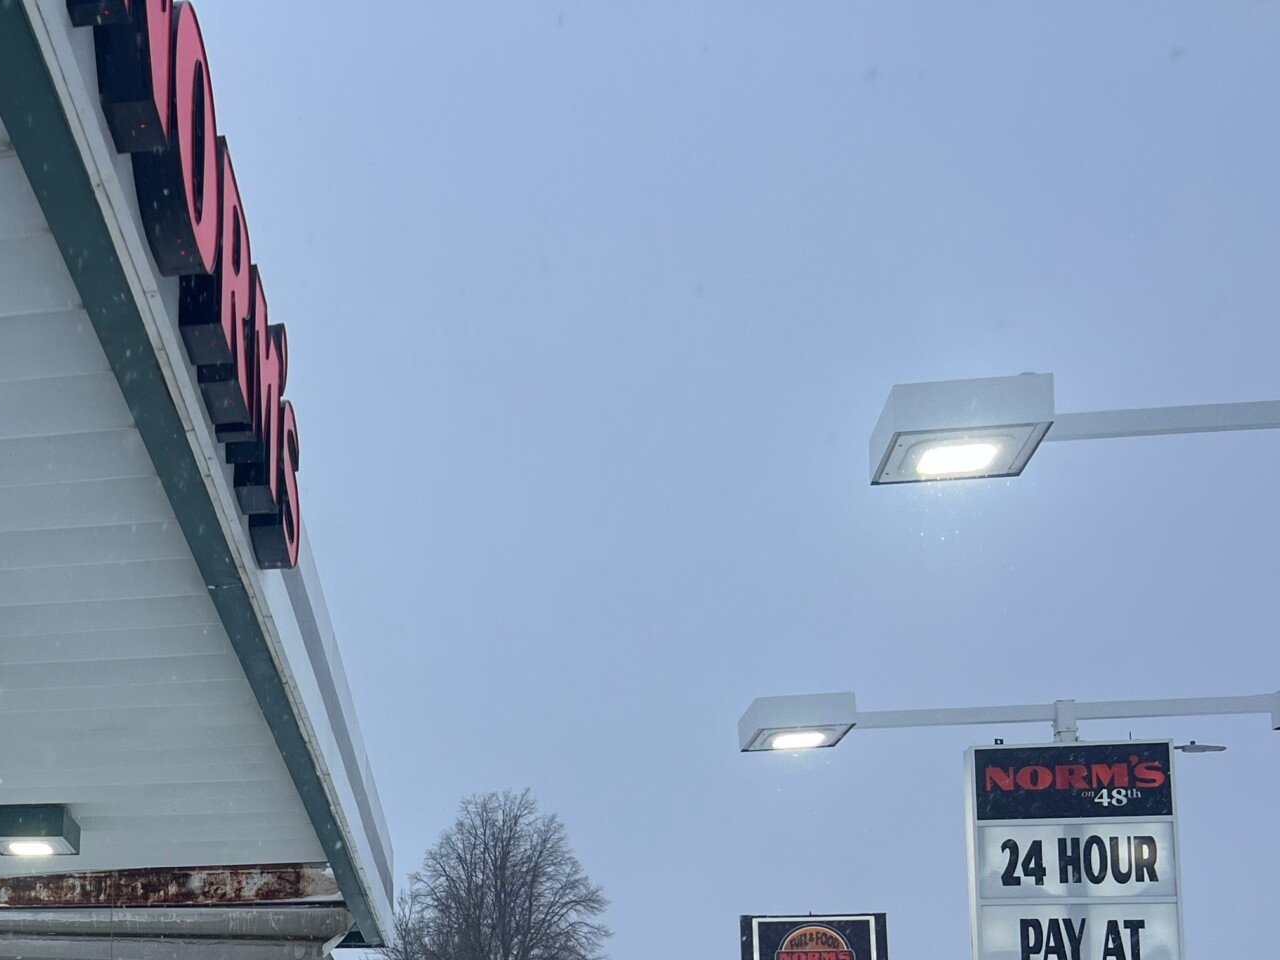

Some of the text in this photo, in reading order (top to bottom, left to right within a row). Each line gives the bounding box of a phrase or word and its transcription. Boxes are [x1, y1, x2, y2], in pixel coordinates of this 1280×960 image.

[985, 755, 1166, 792] NORM'S
[1081, 788, 1142, 807] on 48th
[1000, 834, 1160, 886] 24 HOUR
